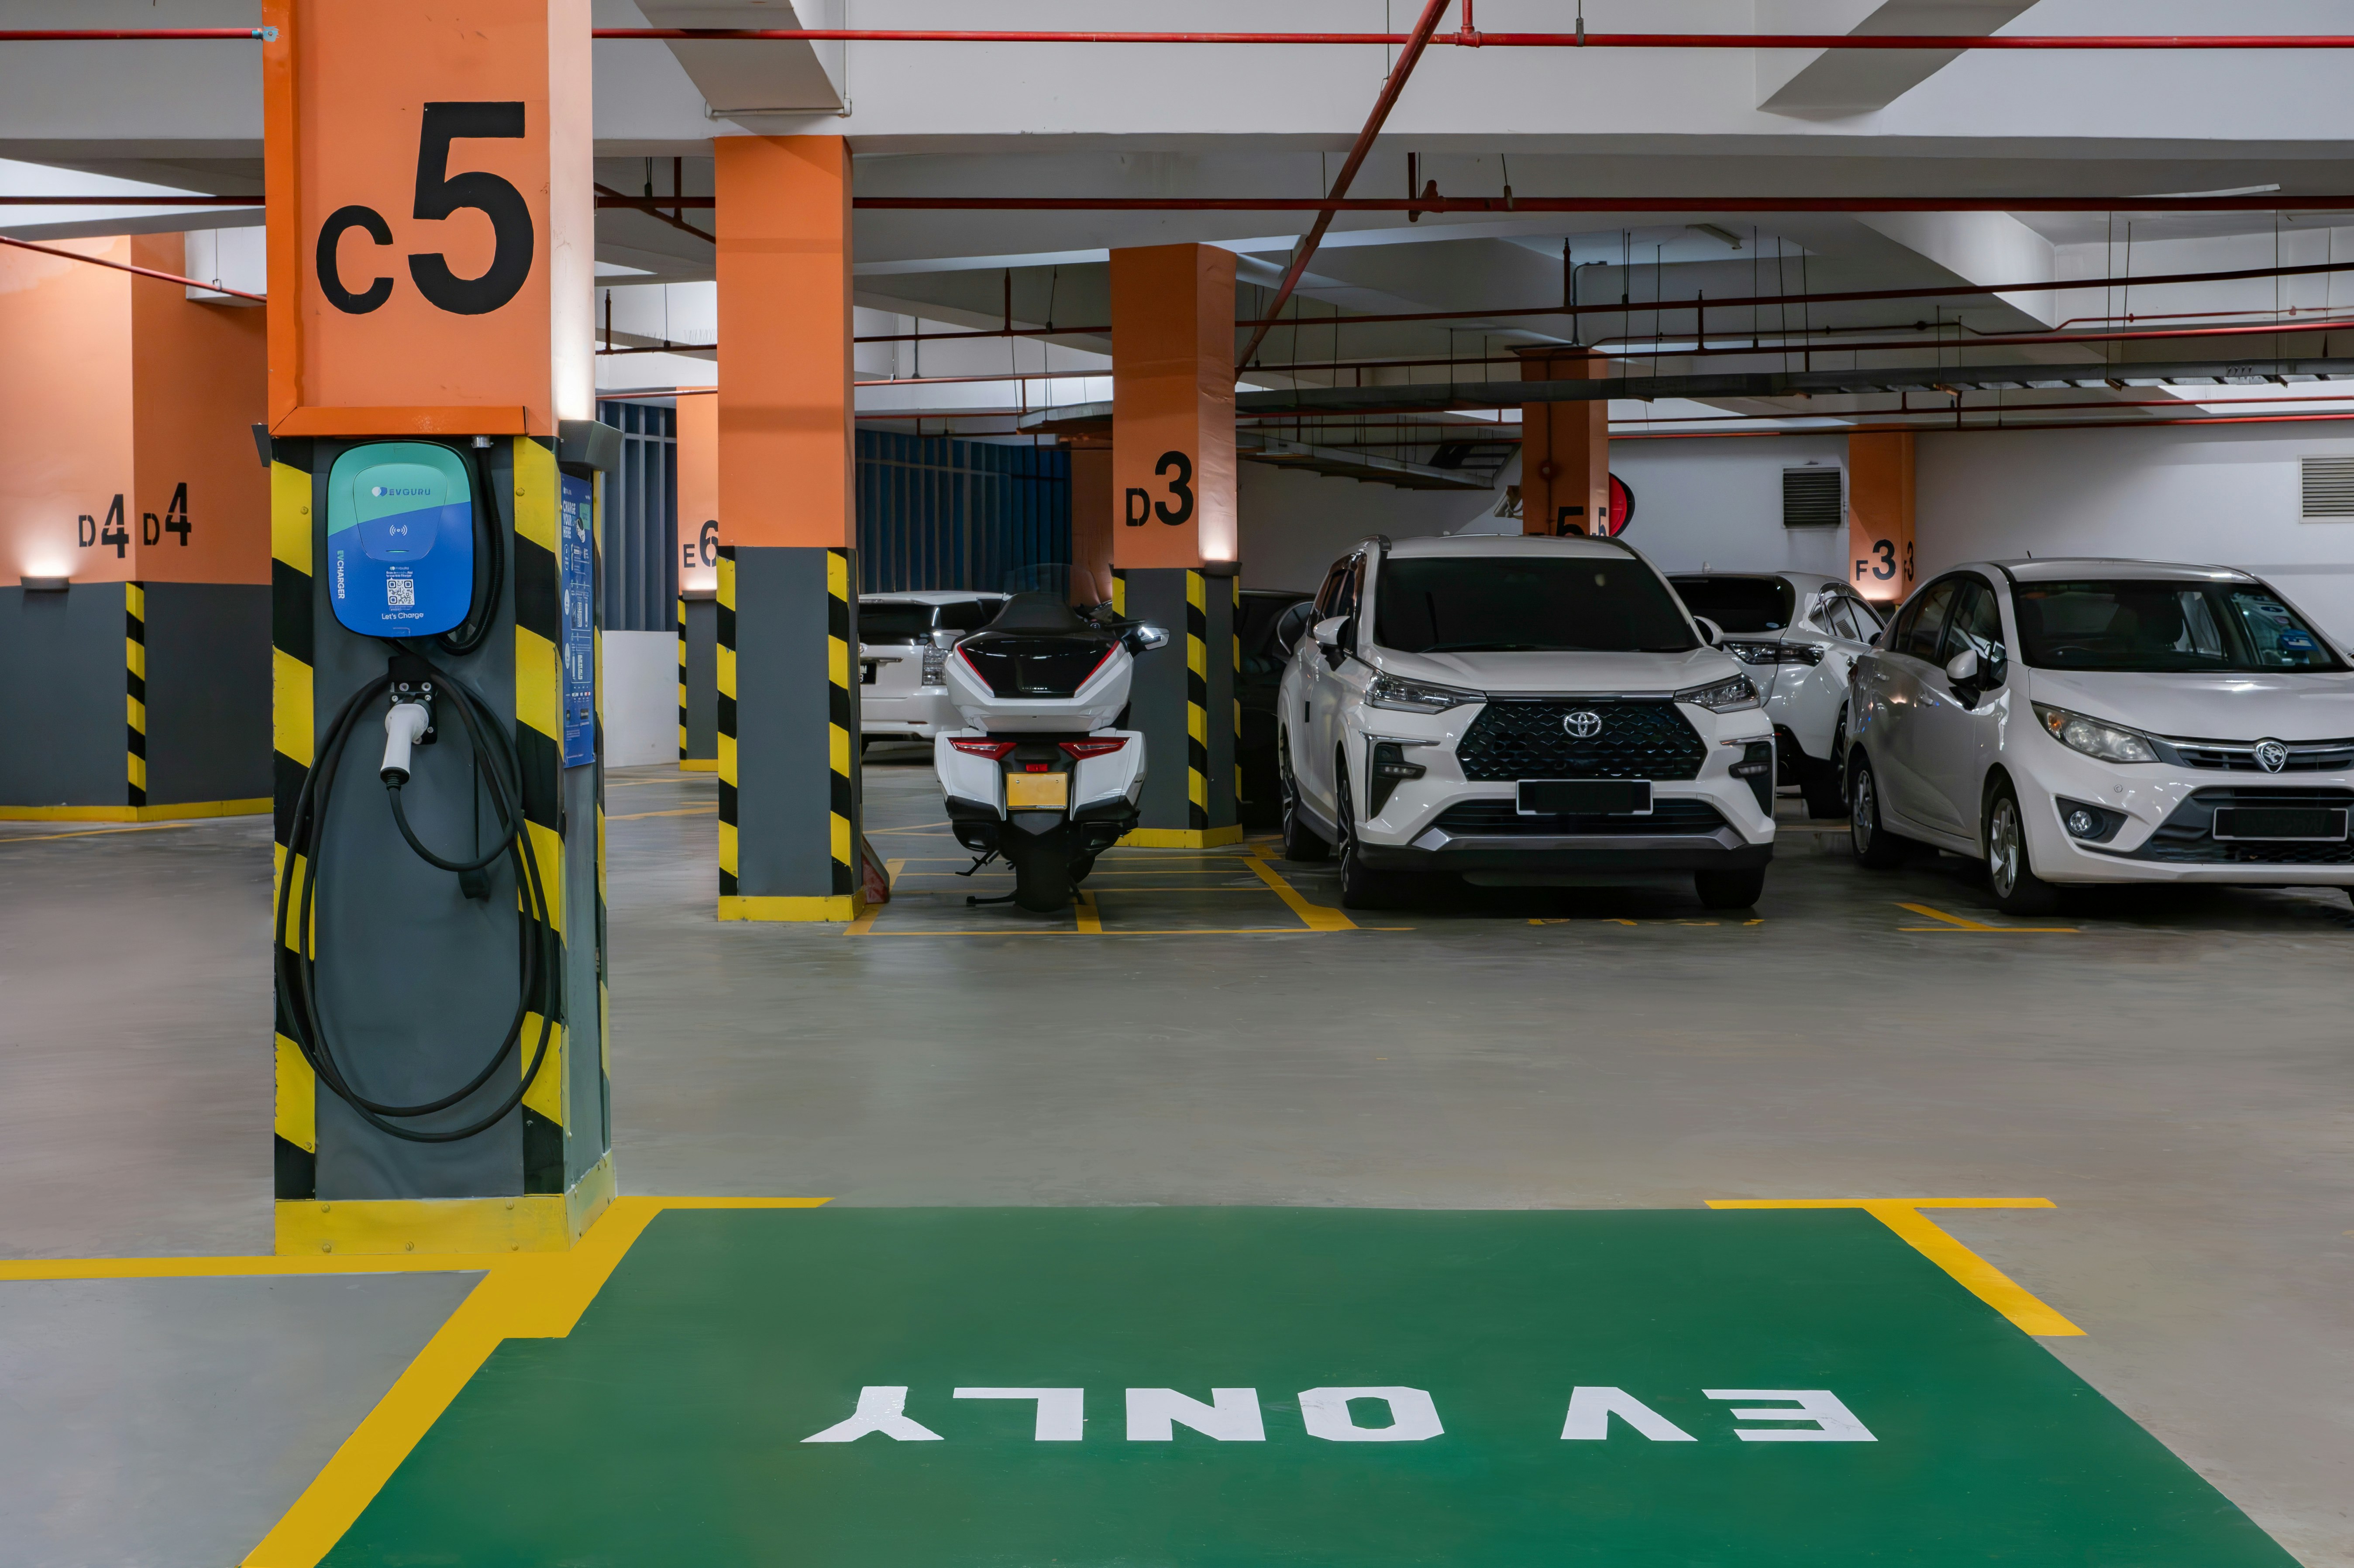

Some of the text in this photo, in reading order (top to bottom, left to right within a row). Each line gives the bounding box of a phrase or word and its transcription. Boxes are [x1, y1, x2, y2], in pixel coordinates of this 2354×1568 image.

[143, 482, 191, 547] D4
[1125, 450, 1194, 526] D3
[79, 494, 129, 558] D4
[683, 520, 718, 567] E6
[337, 550, 345, 599] EVCHARGER
[1856, 539, 1896, 581] F3
[799, 1386, 1879, 1443] EV ONLY
